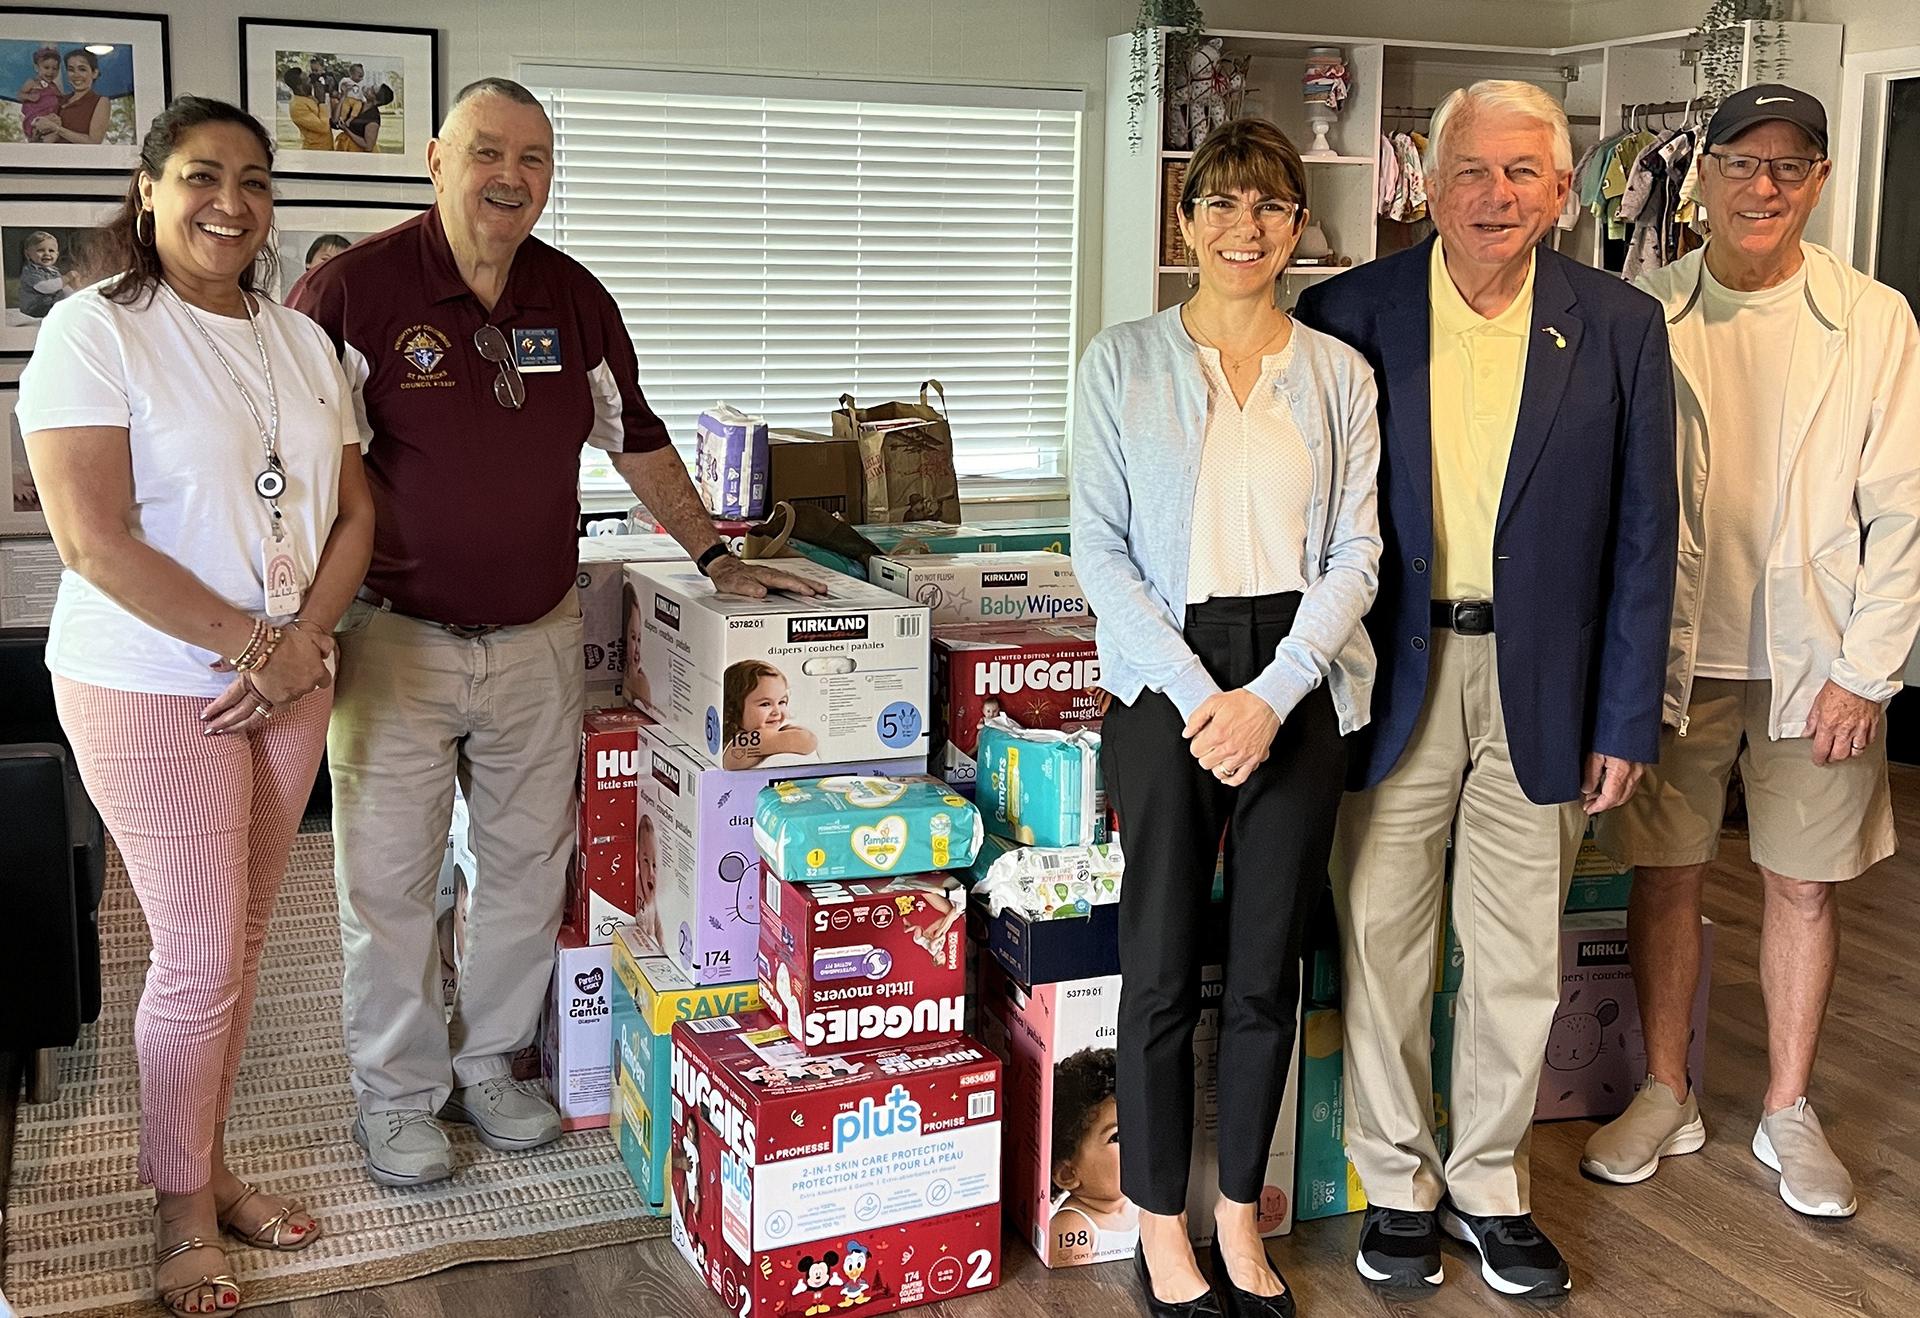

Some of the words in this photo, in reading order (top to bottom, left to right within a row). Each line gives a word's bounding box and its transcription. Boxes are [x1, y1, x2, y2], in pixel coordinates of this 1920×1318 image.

[984, 573, 1026, 582] KIRKLAND
[792, 617, 866, 632] KIRKLAND
[768, 647, 802, 656] diapers
[808, 644, 844, 653] couches
[851, 642, 884, 651] pañales
[706, 715, 713, 741] 5
[882, 714, 898, 738] 5
[732, 730, 760, 748] 168
[952, 768, 976, 778] 100
[598, 780, 621, 790] little
[996, 756, 1006, 823] Pampers
[864, 834, 899, 846] Pampers
[813, 851, 818, 861] 1
[806, 868, 818, 876] 32
[814, 911, 830, 932] 5
[704, 950, 730, 966] 174
[820, 966, 857, 976] OUTSTANDING
[876, 981, 914, 998] little
[572, 998, 594, 1008] Dry
[597, 996, 606, 1004] &
[570, 1006, 608, 1018] Gentle
[806, 996, 965, 1046] HUGGIES
[880, 1049, 983, 1074] HUGGIES
[671, 1042, 756, 1168] HUGGIES
[839, 1101, 854, 1110] THE
[837, 1088, 917, 1153] plus
[924, 1116, 965, 1132] PROMISE
[764, 1153, 774, 1162] LA
[776, 1141, 830, 1160] PROMESSE
[802, 1164, 832, 1178] 2-IN-1
[835, 1160, 858, 1174] SKIN
[862, 1154, 888, 1166] CARE
[892, 1141, 954, 1160] PROTECTION
[722, 1153, 750, 1201] plus
[792, 1172, 858, 1192] PROTECTION
[861, 1170, 866, 1178] 2
[870, 1166, 883, 1177] EN
[886, 1166, 890, 1174] 1
[894, 1160, 921, 1172] POUR
[924, 1158, 936, 1166] LA
[938, 1151, 964, 1163] PEAU
[1325, 1180, 1336, 1203] 136
[1058, 1230, 1088, 1249] 198
[904, 1270, 919, 1282] 174
[966, 1249, 992, 1288] 2
[899, 1286, 924, 1298] COUCHES
